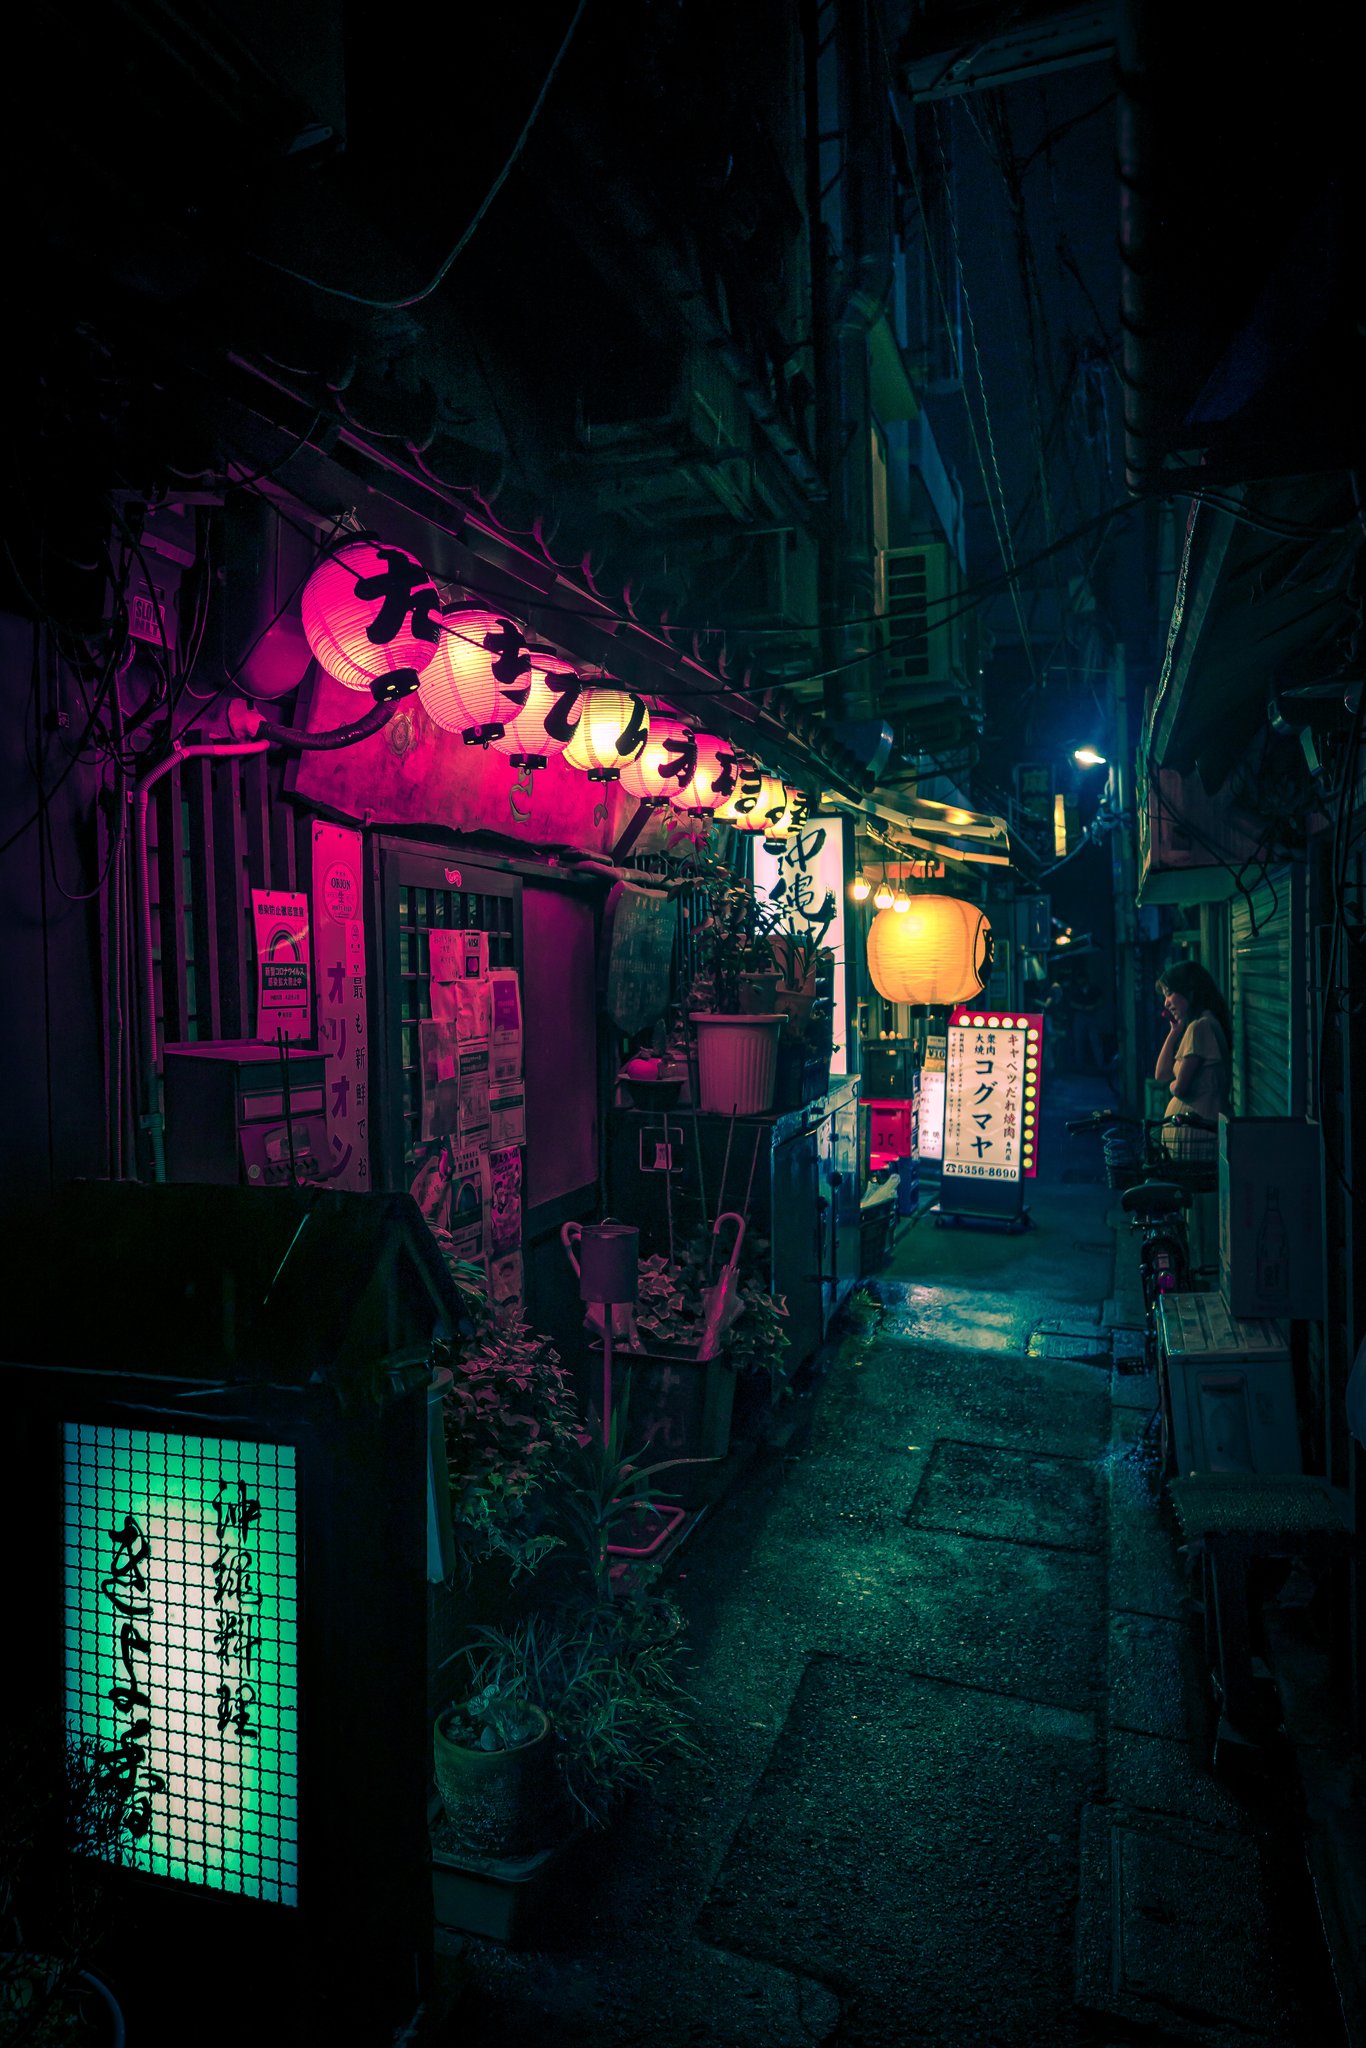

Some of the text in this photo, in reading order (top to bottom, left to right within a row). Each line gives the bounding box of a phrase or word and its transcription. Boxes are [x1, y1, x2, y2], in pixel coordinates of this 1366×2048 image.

[257, 904, 305, 918] 感染防止徹底宣言
[264, 967, 305, 977] 新型コロナウイルス
[327, 961, 353, 1179] オリオン
[352, 975, 369, 1178] 最も新鮮でお
[970, 1060, 998, 1159] コグマヤ
[957, 1164, 1017, 1179] 5356-8690
